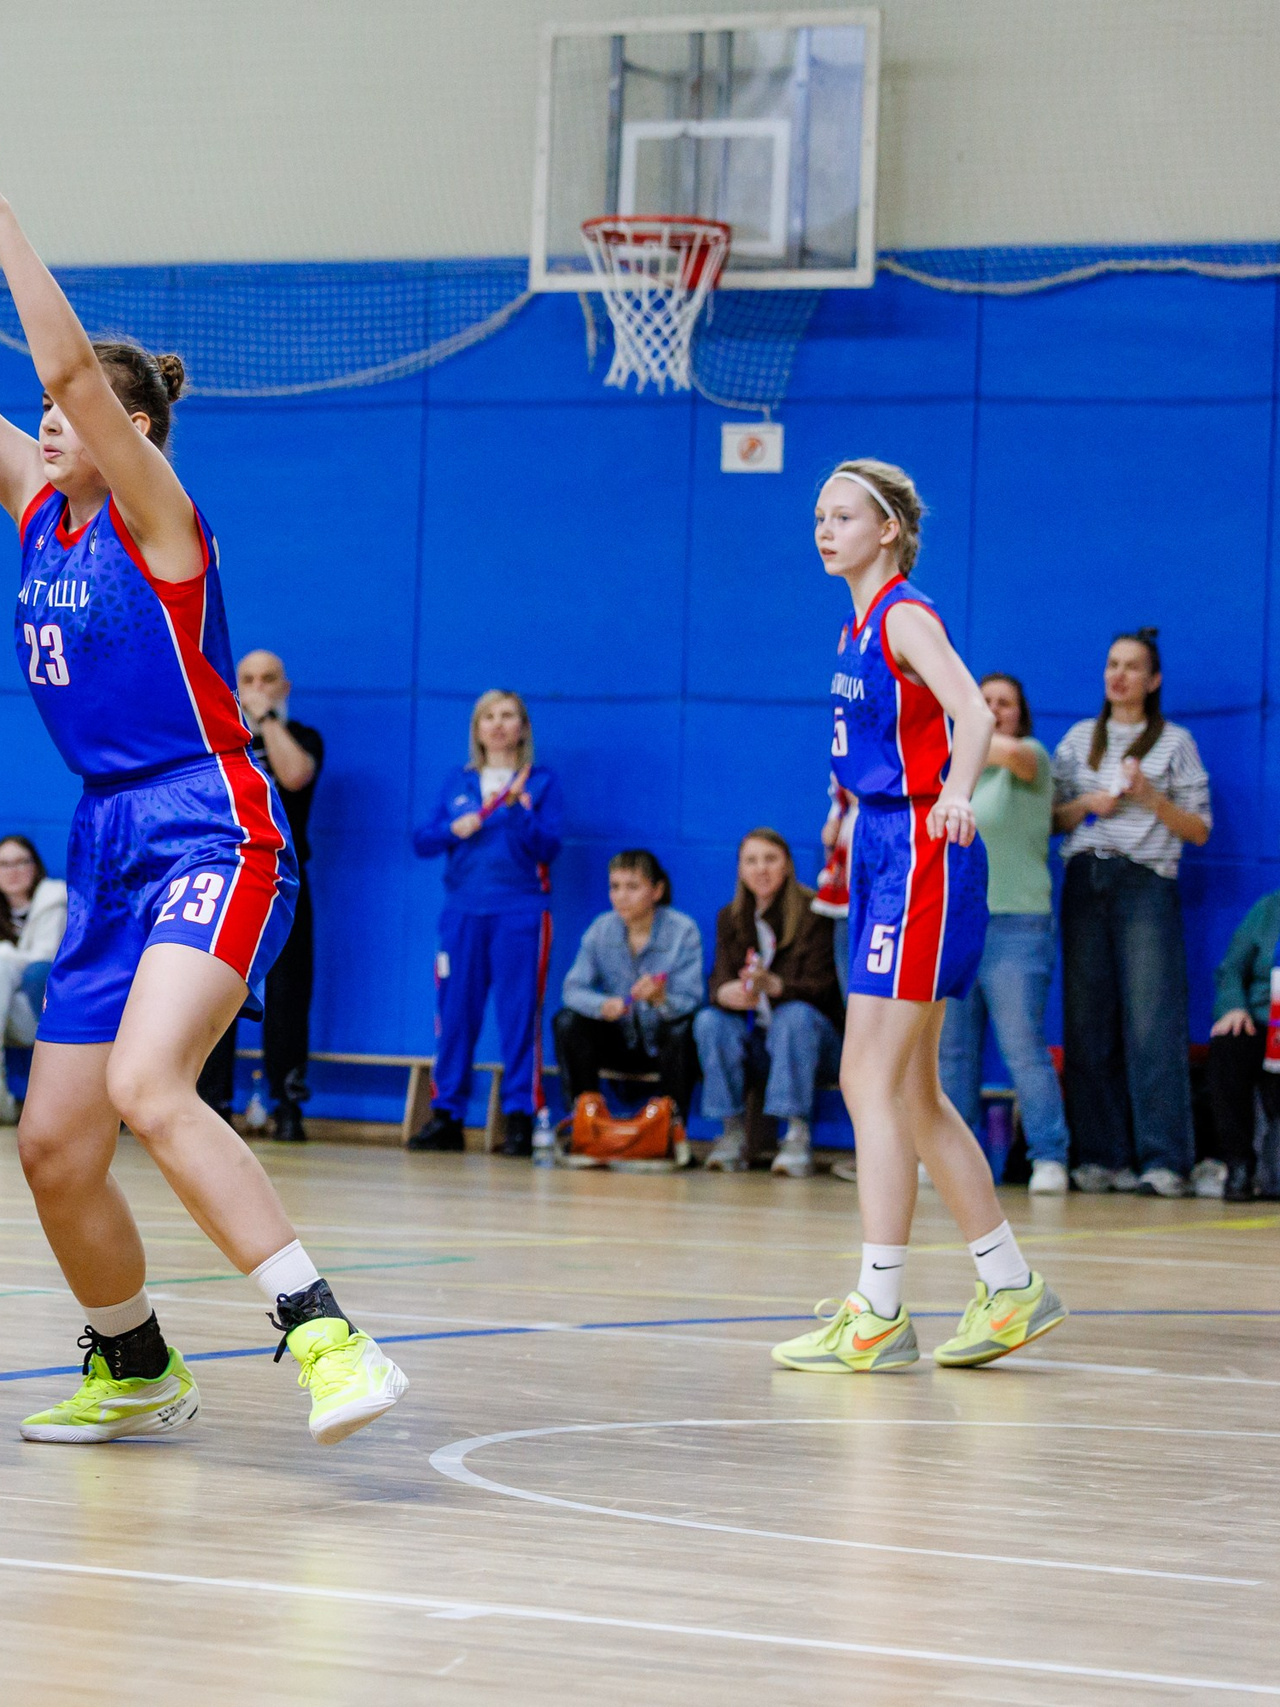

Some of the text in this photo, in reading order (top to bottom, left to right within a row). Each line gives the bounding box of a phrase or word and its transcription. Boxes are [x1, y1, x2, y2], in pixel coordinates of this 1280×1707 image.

[23, 623, 70, 686] 23
[154, 872, 225, 926] 23
[866, 923, 896, 974] 5
